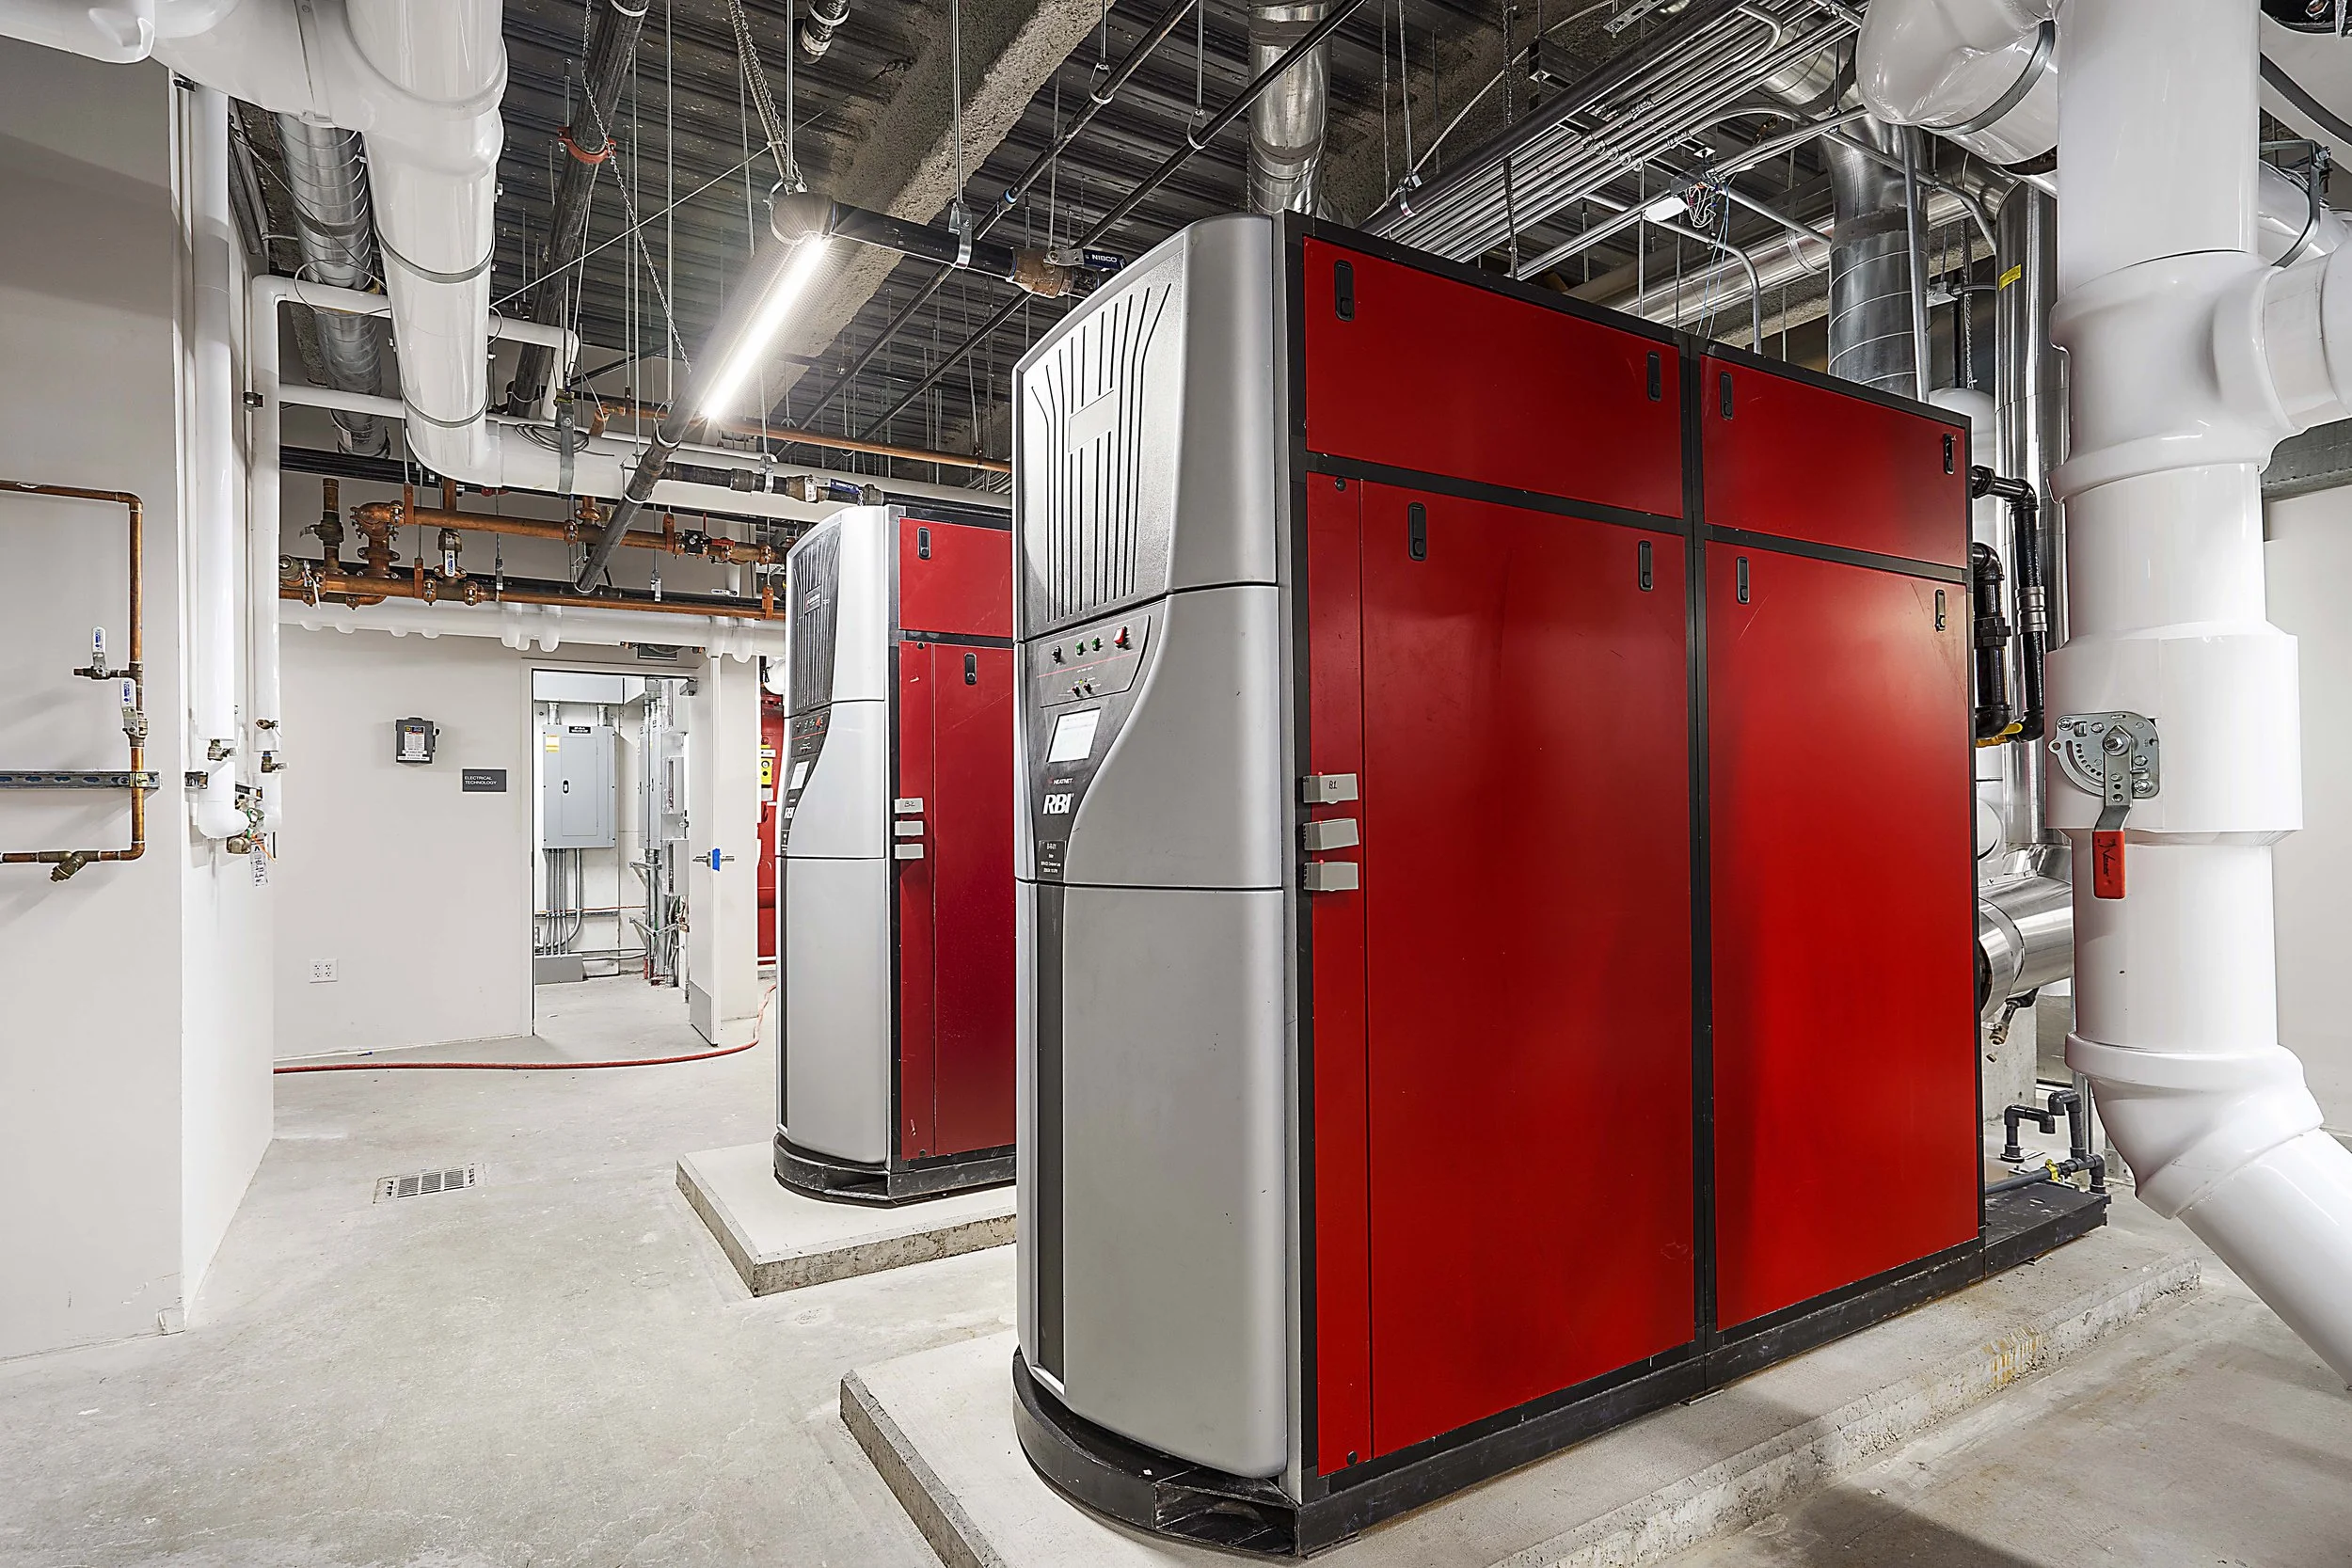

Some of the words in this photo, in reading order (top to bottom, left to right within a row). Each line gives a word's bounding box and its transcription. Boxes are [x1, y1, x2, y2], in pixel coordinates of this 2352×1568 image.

[1091, 254, 1118, 263] NIBCO
[904, 800, 916, 808] B2
[1042, 793, 1072, 816] RBI
